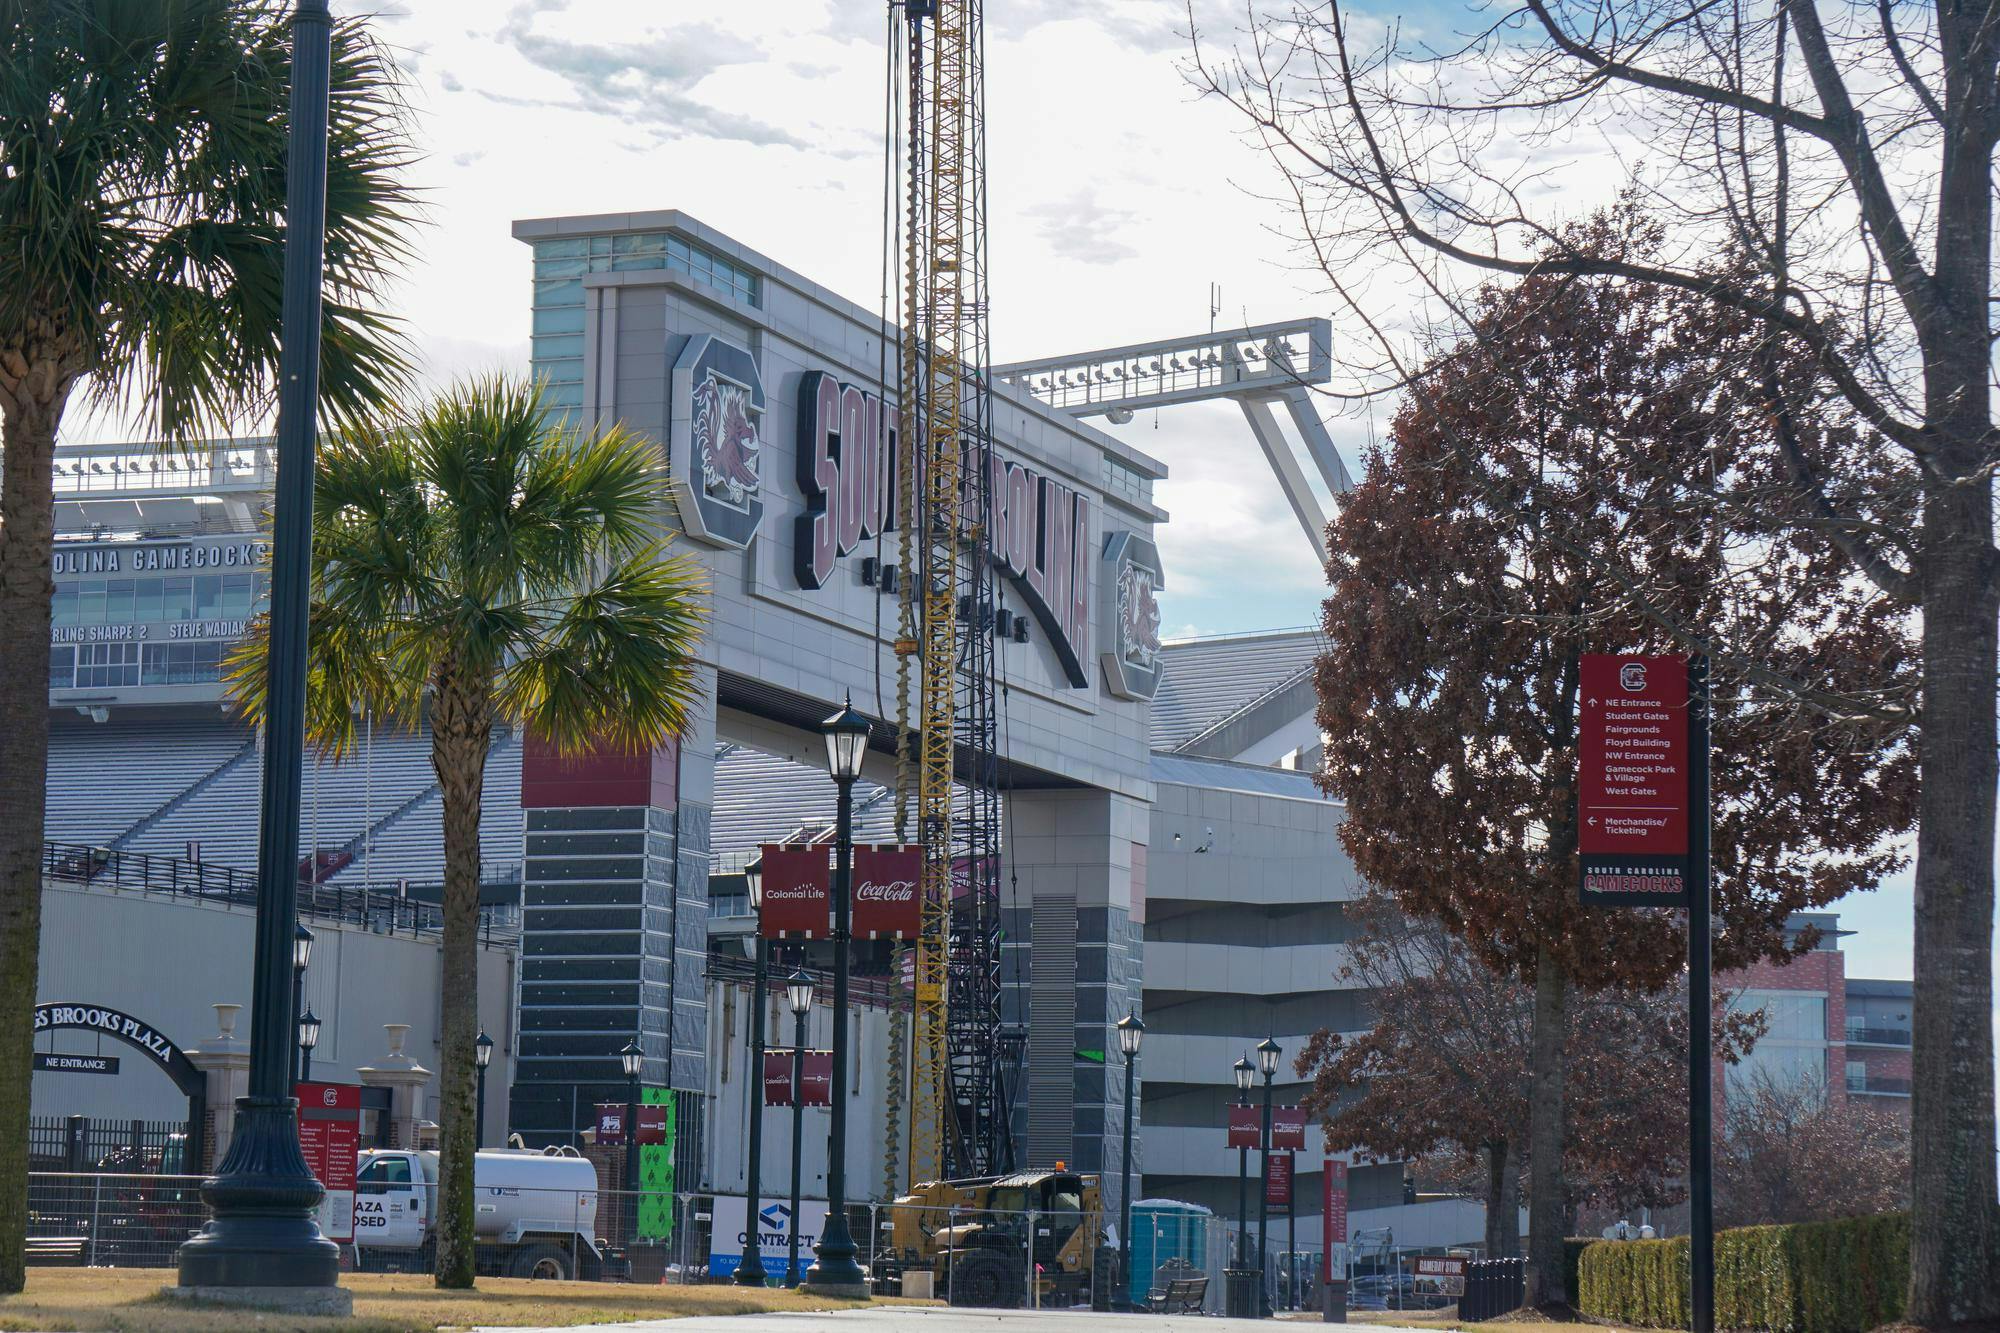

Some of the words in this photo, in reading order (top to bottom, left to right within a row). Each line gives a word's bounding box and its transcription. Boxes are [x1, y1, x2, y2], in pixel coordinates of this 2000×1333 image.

[53, 550, 119, 574] OLINA
[133, 543, 268, 570] GAMECOCKS
[52, 626, 85, 642] RLING
[90, 625, 133, 640] SHARPE
[140, 624, 147, 639] 2
[169, 623, 202, 638] STEVE
[205, 620, 247, 637] WADIAK
[1605, 699, 1619, 707] NE
[1621, 699, 1661, 707] Entrance
[1605, 712, 1641, 720] Student
[1643, 712, 1670, 720] Gates
[1605, 725, 1660, 735] Fairgrounds
[1605, 738, 1631, 748] Floyd
[1633, 739, 1671, 748] Building
[1605, 752, 1622, 760] NW
[1625, 752, 1665, 760] Entrance
[1605, 765, 1653, 773] Gamecock
[1655, 765, 1676, 774] Park
[1605, 774, 1612, 782] &
[1614, 774, 1645, 783] Village
[1605, 787, 1629, 795] West
[1631, 787, 1657, 795] Gates
[1605, 817, 1668, 827] Merchandise/
[1605, 826, 1647, 836] Ticketing
[1587, 866, 1621, 874] SOUTH
[1627, 867, 1680, 875] CAROLINA
[1584, 875, 1683, 893] GAMECOCKS
[766, 889, 806, 899] Colonial
[808, 889, 825, 899] Life
[856, 880, 918, 901] Coca-Cola
[51, 1007, 121, 1031] BROOKS
[121, 1018, 172, 1063] PLAZA
[46, 1057, 59, 1067] NE
[60, 1058, 106, 1070] ENTRANCE
[355, 1201, 384, 1213] AZA
[354, 1216, 386, 1227] OSED
